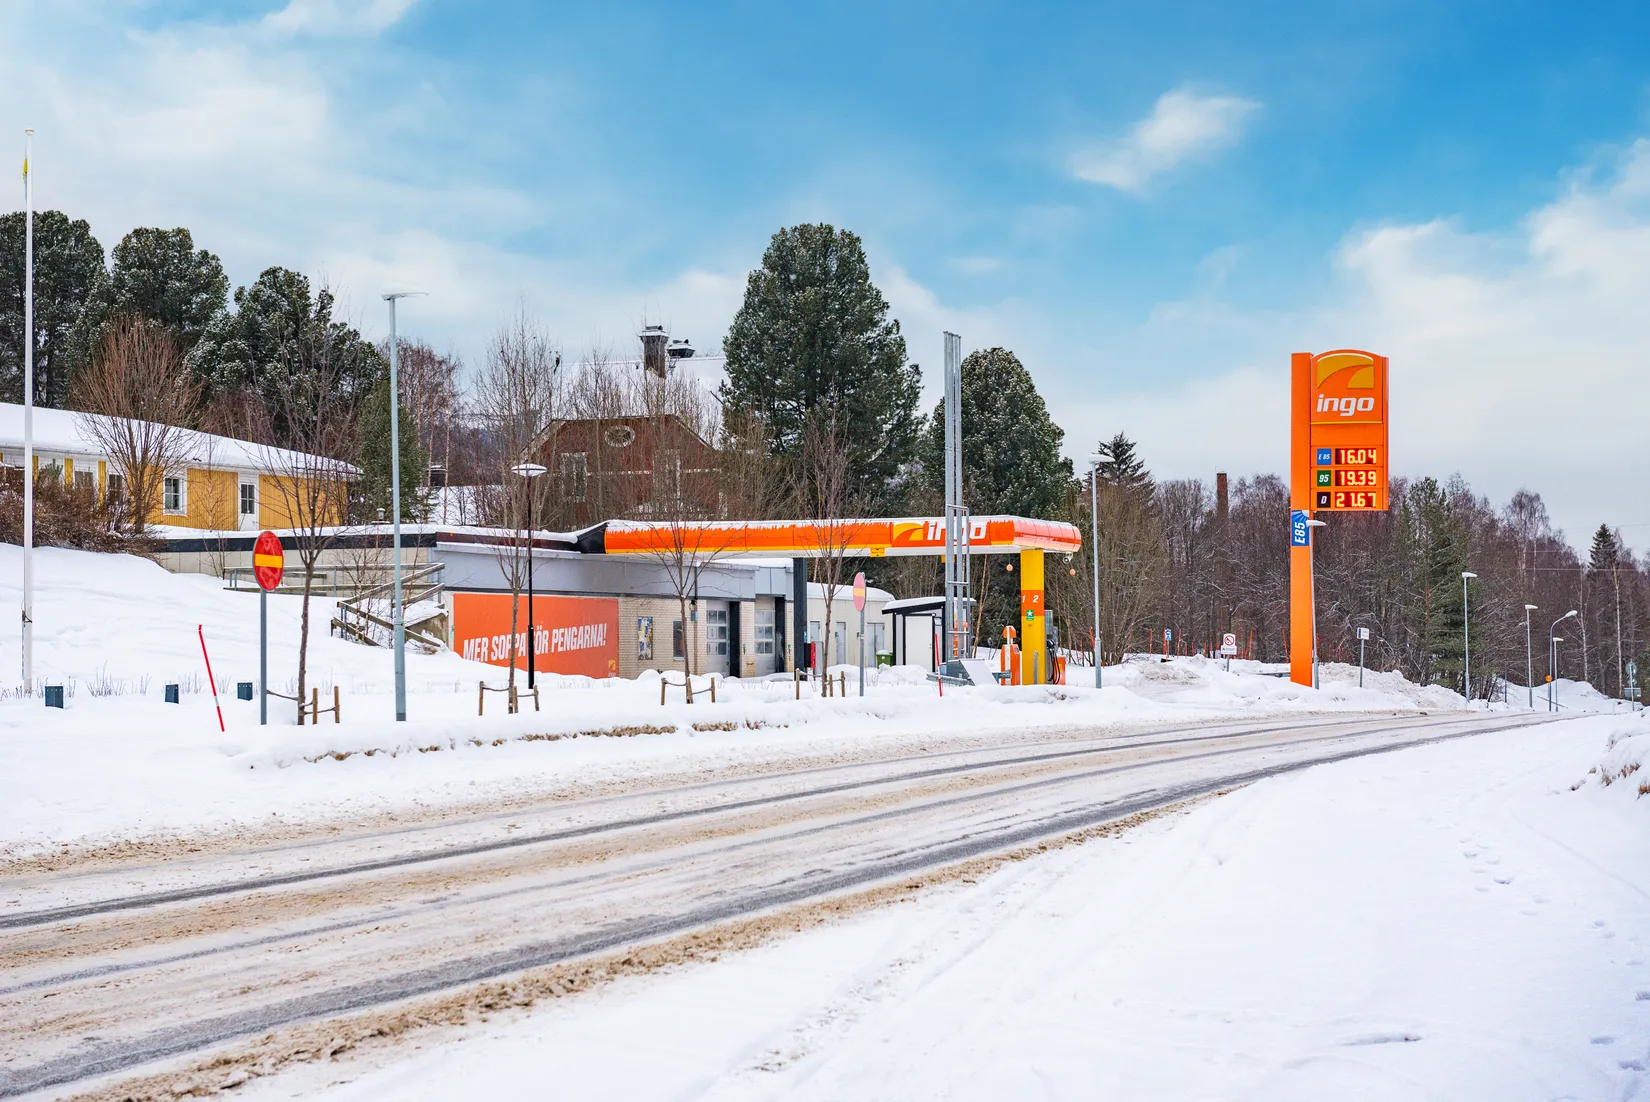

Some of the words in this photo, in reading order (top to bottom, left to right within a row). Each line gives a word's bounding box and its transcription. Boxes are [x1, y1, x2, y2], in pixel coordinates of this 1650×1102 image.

[1316, 394, 1375, 417] ingo
[1340, 449, 1377, 464] 16.04
[1319, 474, 1330, 483] 95
[1340, 471, 1377, 486] 19.39
[1321, 495, 1327, 504] D
[1336, 492, 1377, 507] 21.67
[1294, 522, 1306, 544] E85
[1032, 594, 1039, 603] 2
[463, 637, 489, 662] MER
[533, 625, 549, 655] ÖR
[551, 623, 608, 653] PENGARNA!
